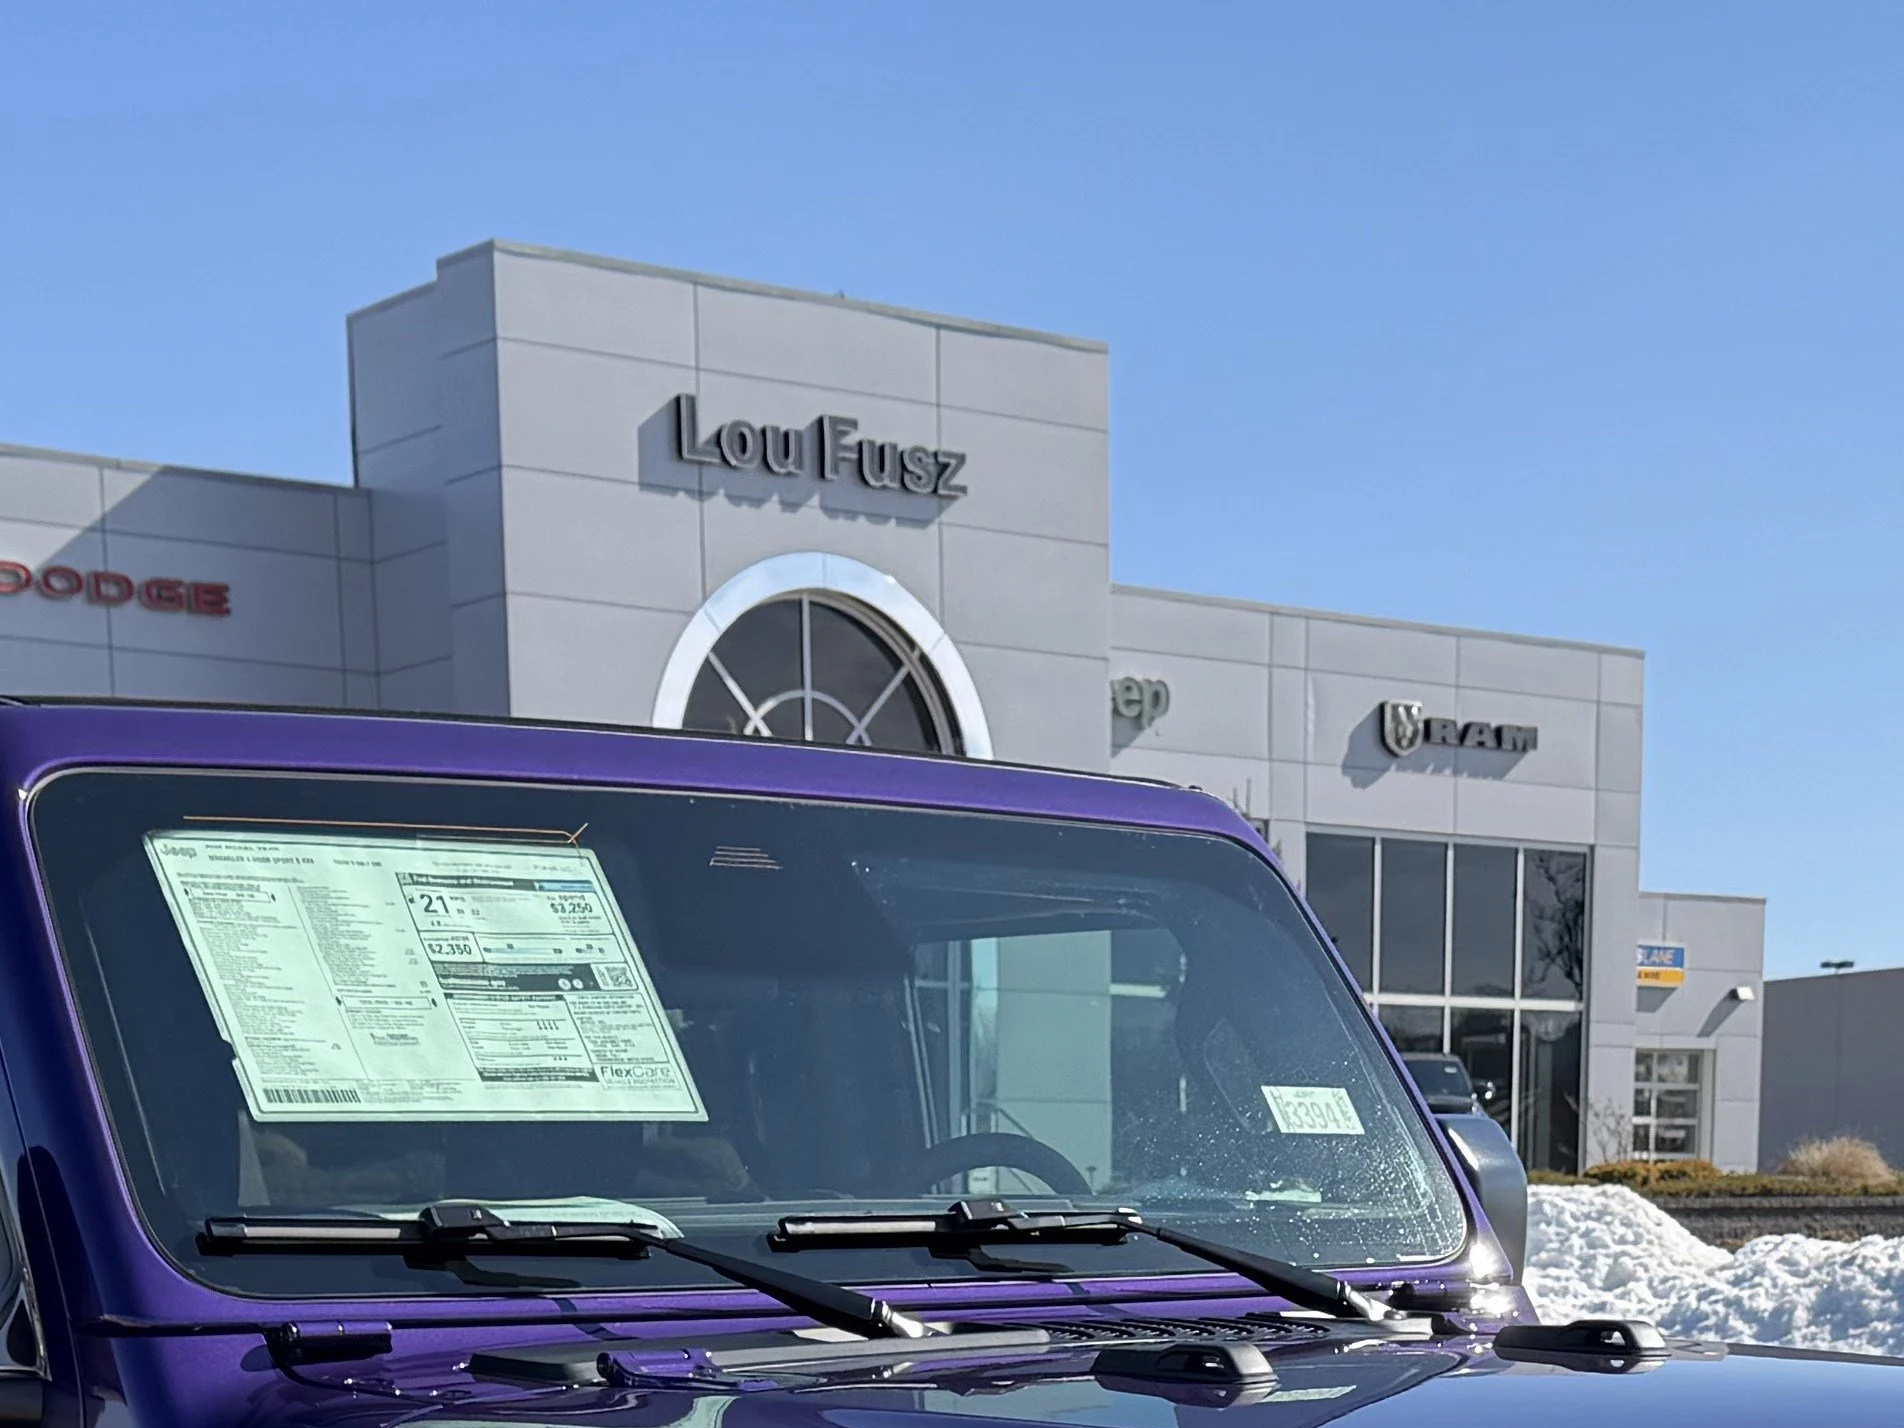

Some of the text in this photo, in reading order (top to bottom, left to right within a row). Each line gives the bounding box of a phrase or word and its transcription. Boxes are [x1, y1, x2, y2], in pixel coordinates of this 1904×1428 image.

[674, 393, 968, 498] Lou Fusz
[1424, 717, 1538, 752] RAM
[419, 893, 450, 914] 21
[601, 1065, 670, 1079] FlexCare
